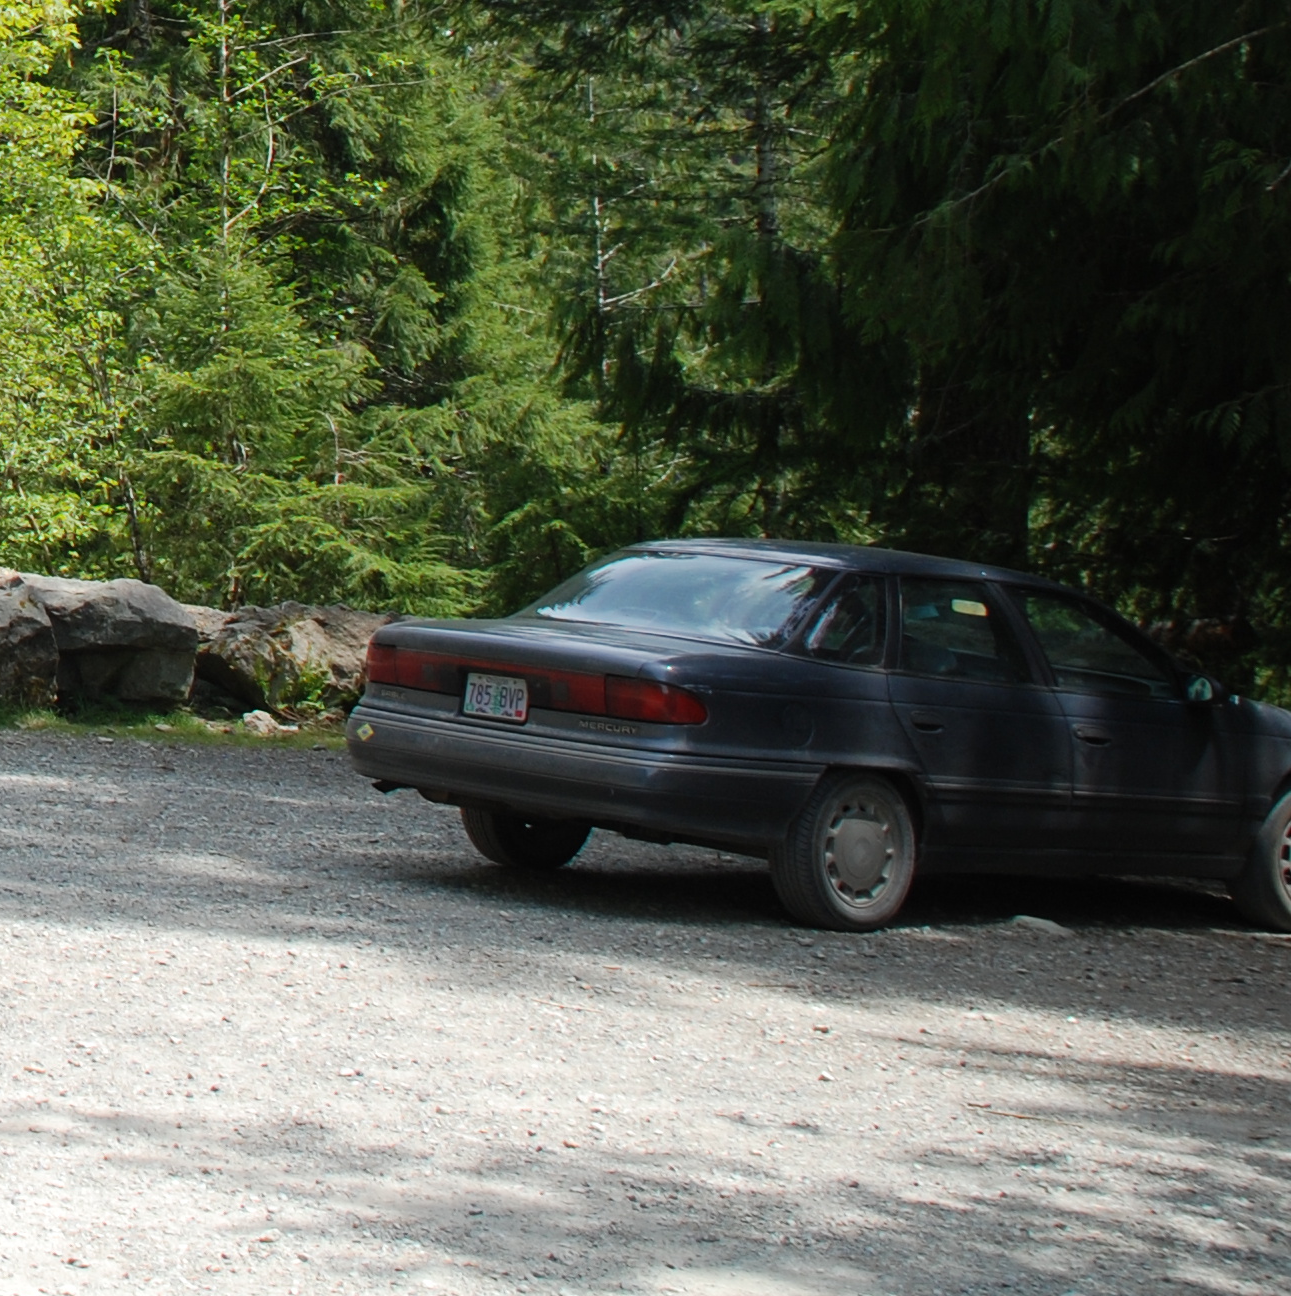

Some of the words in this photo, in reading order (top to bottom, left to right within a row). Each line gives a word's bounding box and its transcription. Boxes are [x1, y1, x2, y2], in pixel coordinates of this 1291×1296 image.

[469, 683, 492, 706] 785
[499, 686, 524, 710] BVP
[579, 720, 638, 735] MERCURY
